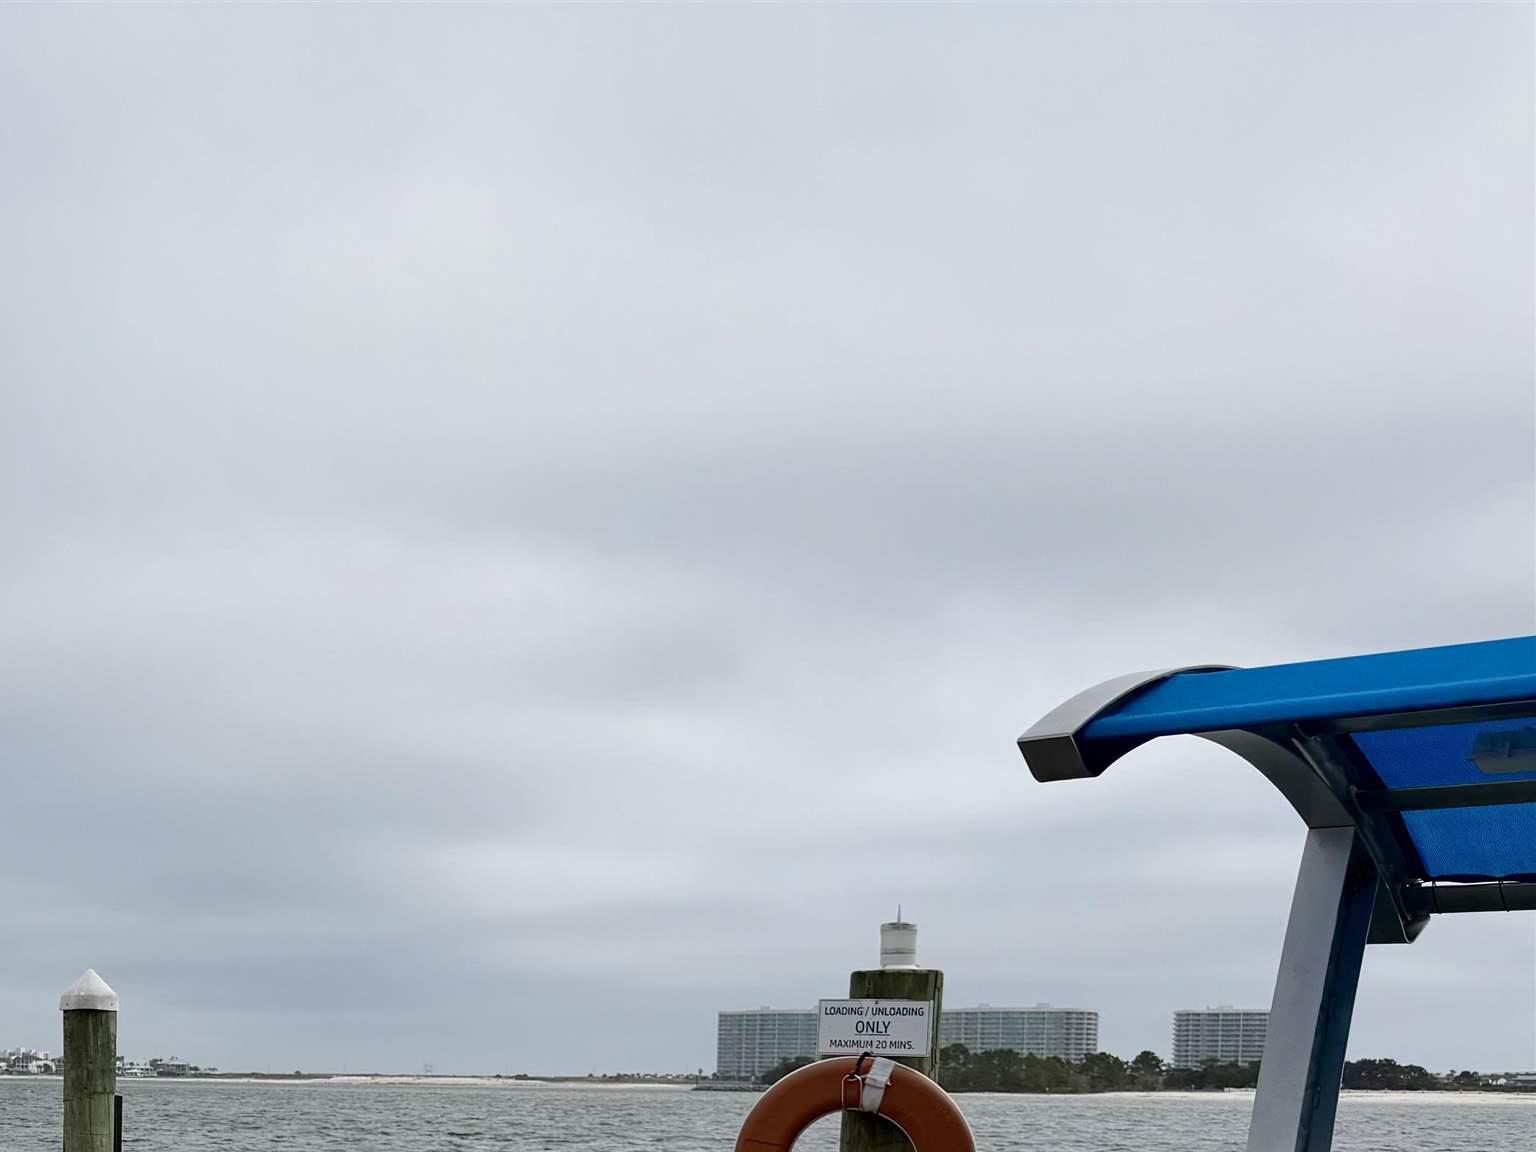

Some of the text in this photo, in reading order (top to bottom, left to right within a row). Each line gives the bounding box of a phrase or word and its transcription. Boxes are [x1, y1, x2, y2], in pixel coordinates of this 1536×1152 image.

[824, 1006, 863, 1016] LOADING
[871, 1007, 924, 1016] UNLOADING
[855, 1020, 891, 1034] ONLY
[829, 1039, 915, 1050] MAXIMUM 20 MINS.
